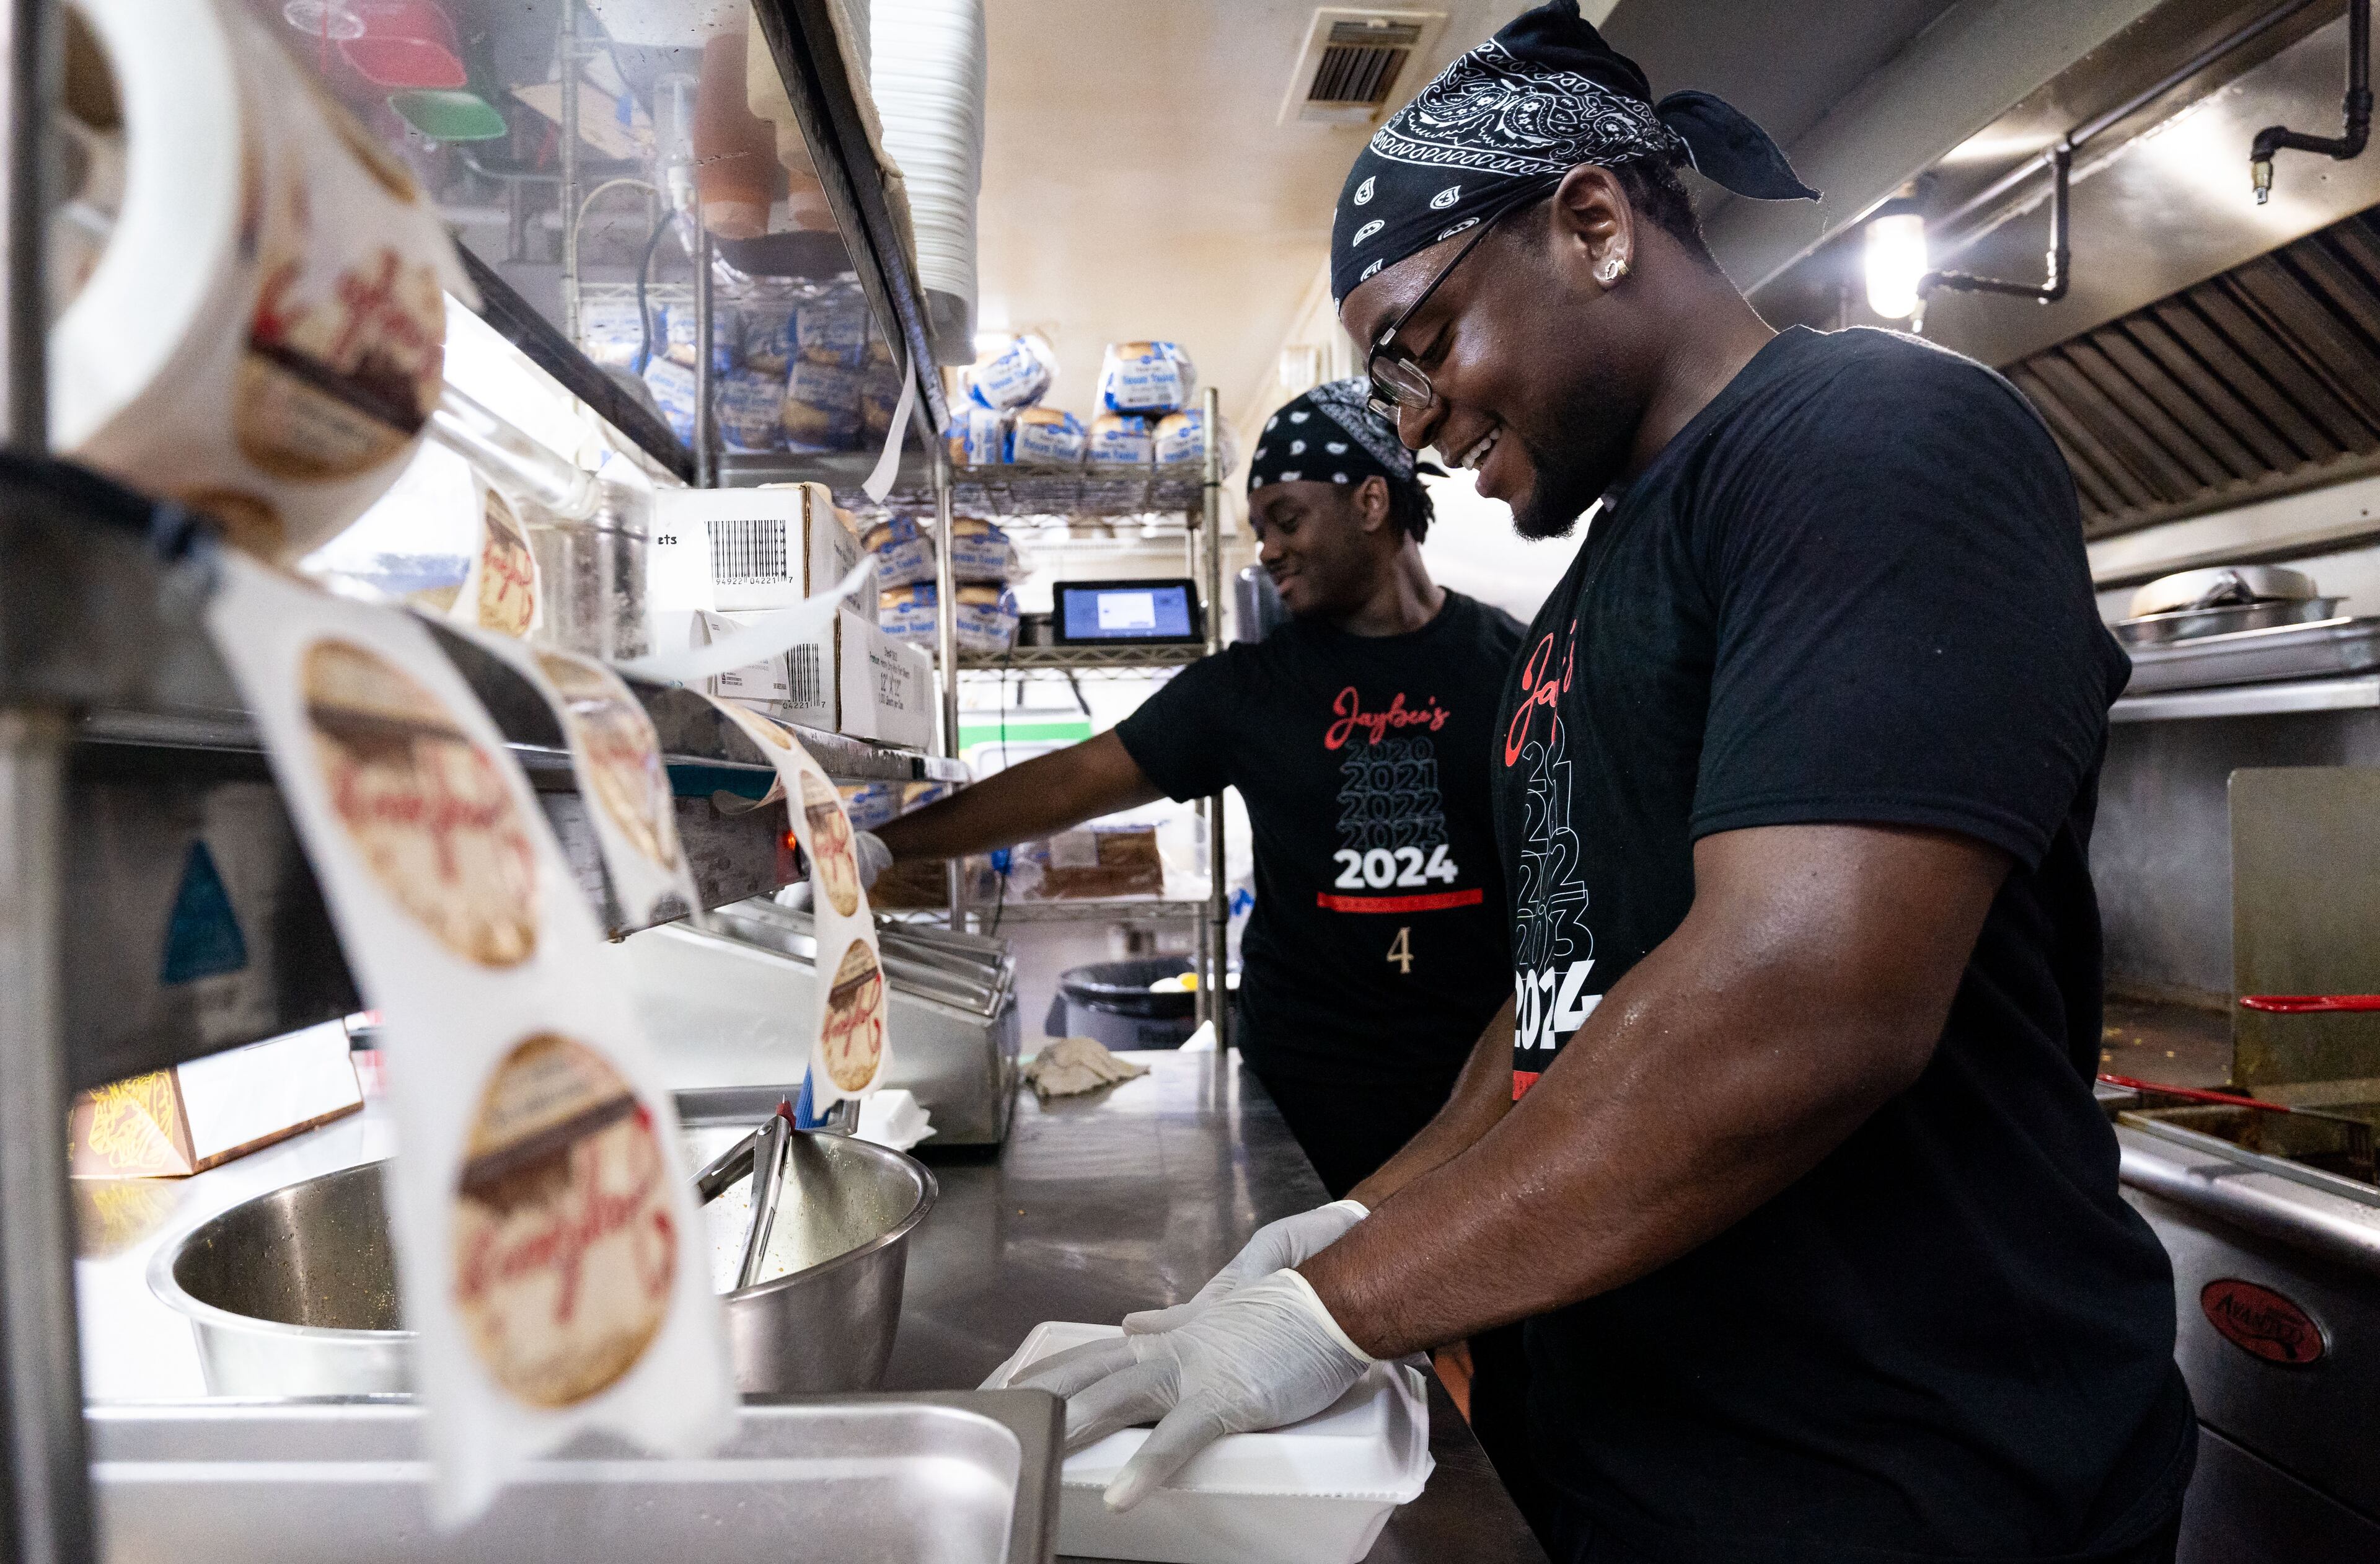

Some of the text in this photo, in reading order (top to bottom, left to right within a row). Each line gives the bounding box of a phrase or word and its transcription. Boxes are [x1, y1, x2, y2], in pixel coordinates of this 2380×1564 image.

[1339, 759, 1438, 793] 2021
[1336, 789, 1442, 823] 2022
[1333, 844, 1458, 889] 2024
[1386, 927, 1415, 974] 4
